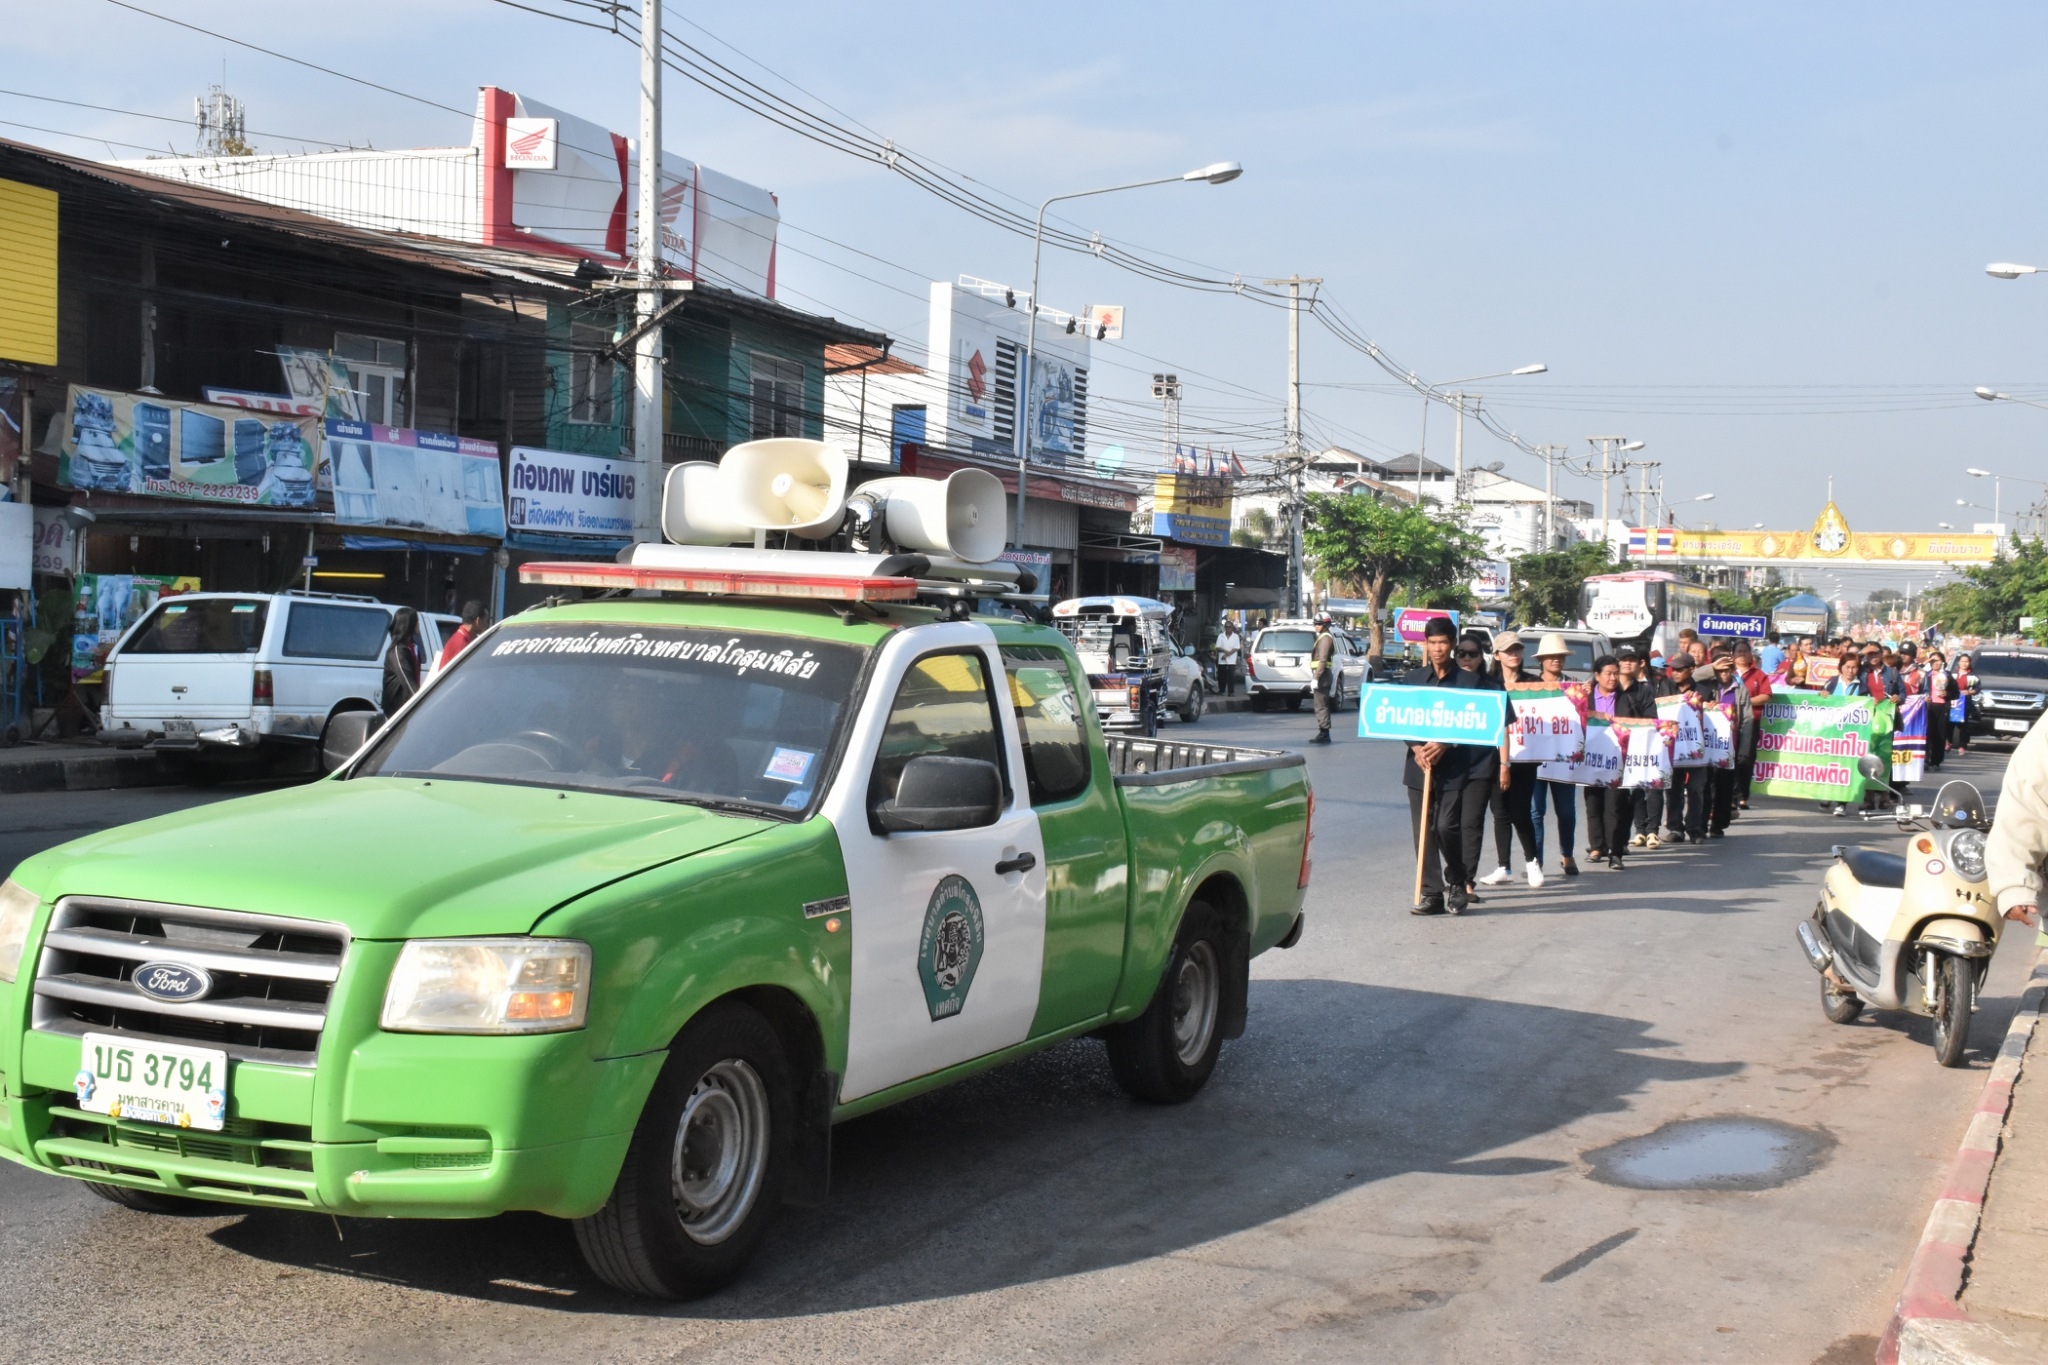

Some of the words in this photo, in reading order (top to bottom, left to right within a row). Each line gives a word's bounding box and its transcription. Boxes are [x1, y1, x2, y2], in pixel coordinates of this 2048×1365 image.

[510, 154, 548, 162] HONDA
[1682, 539, 1742, 553] ทรงพระเจริญ
[1702, 616, 1762, 635] อำเภอกุดรัง
[1375, 697, 1488, 730] อำเภอเชียงยืน
[805, 898, 850, 915] RANGER
[149, 968, 191, 993] Ford
[95, 1045, 134, 1083] บธ
[143, 1053, 213, 1094] 3794
[117, 1093, 185, 1114] มหาสารคาม
